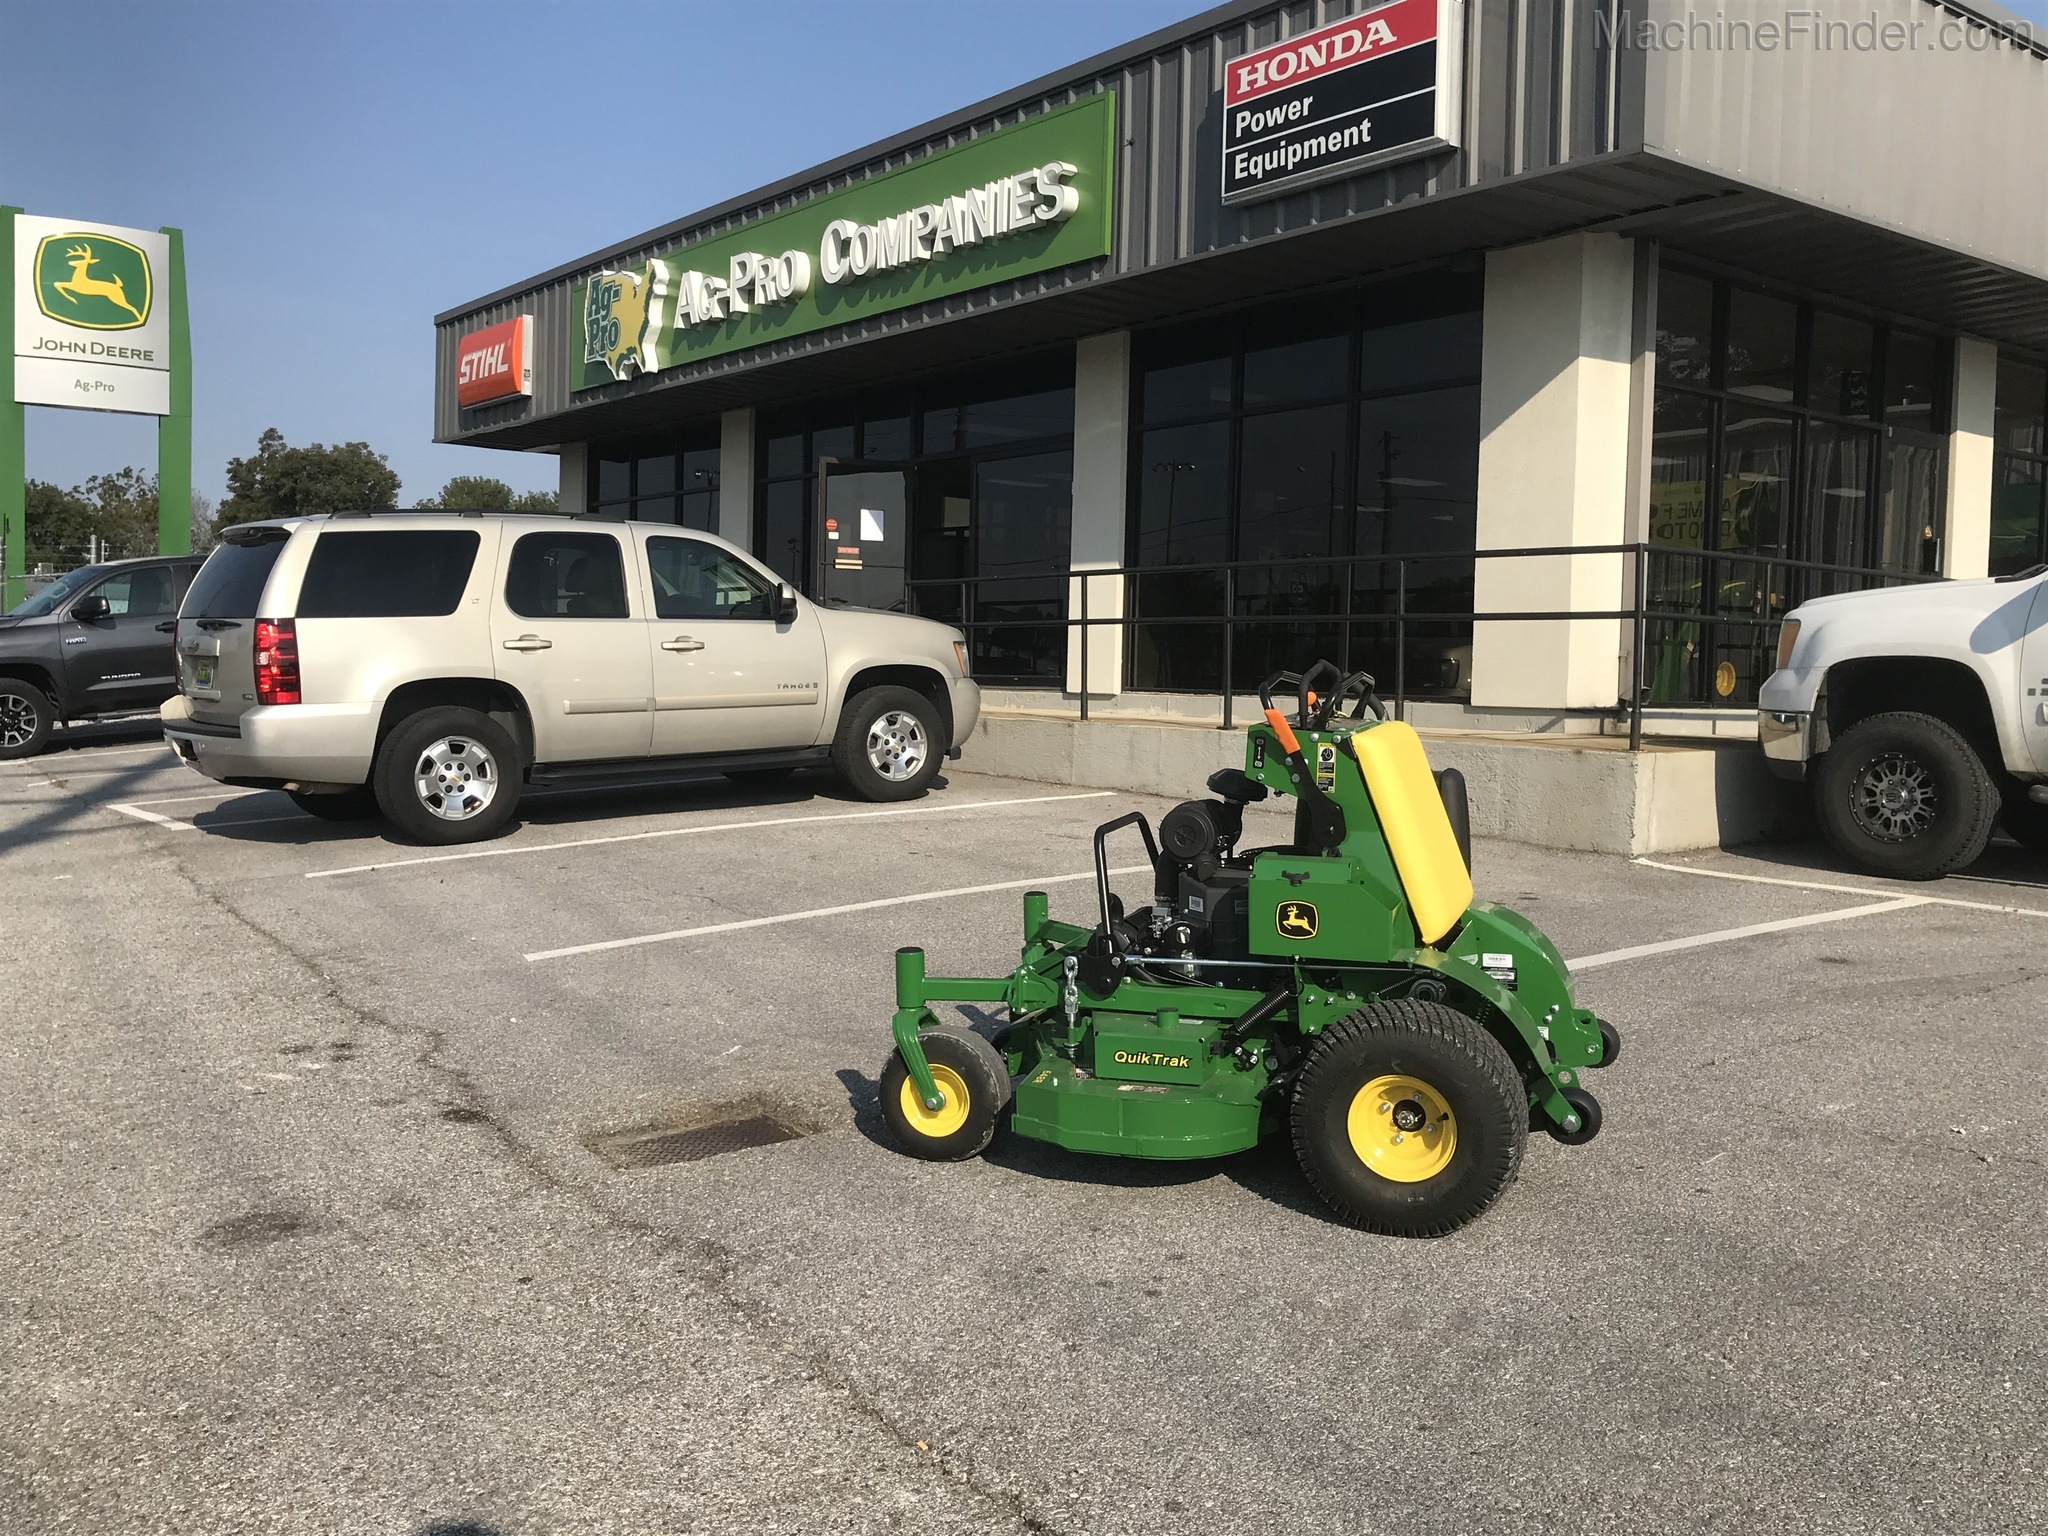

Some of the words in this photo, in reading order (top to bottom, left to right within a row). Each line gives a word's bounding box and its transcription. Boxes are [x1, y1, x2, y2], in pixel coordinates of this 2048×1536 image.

[1236, 18, 1398, 95] HONDA
[1235, 95, 1314, 138] Power
[1235, 117, 1372, 180] Equipment
[820, 160, 1079, 284] COMPANIES
[32, 336, 86, 354] JOHN
[90, 341, 154, 361] DEERE
[587, 317, 620, 359] Pro
[459, 343, 508, 385] STIHL
[74, 379, 115, 393] Ag-Pro
[777, 682, 811, 690] TAHOE
[1113, 1050, 1190, 1068] QuikTrak
